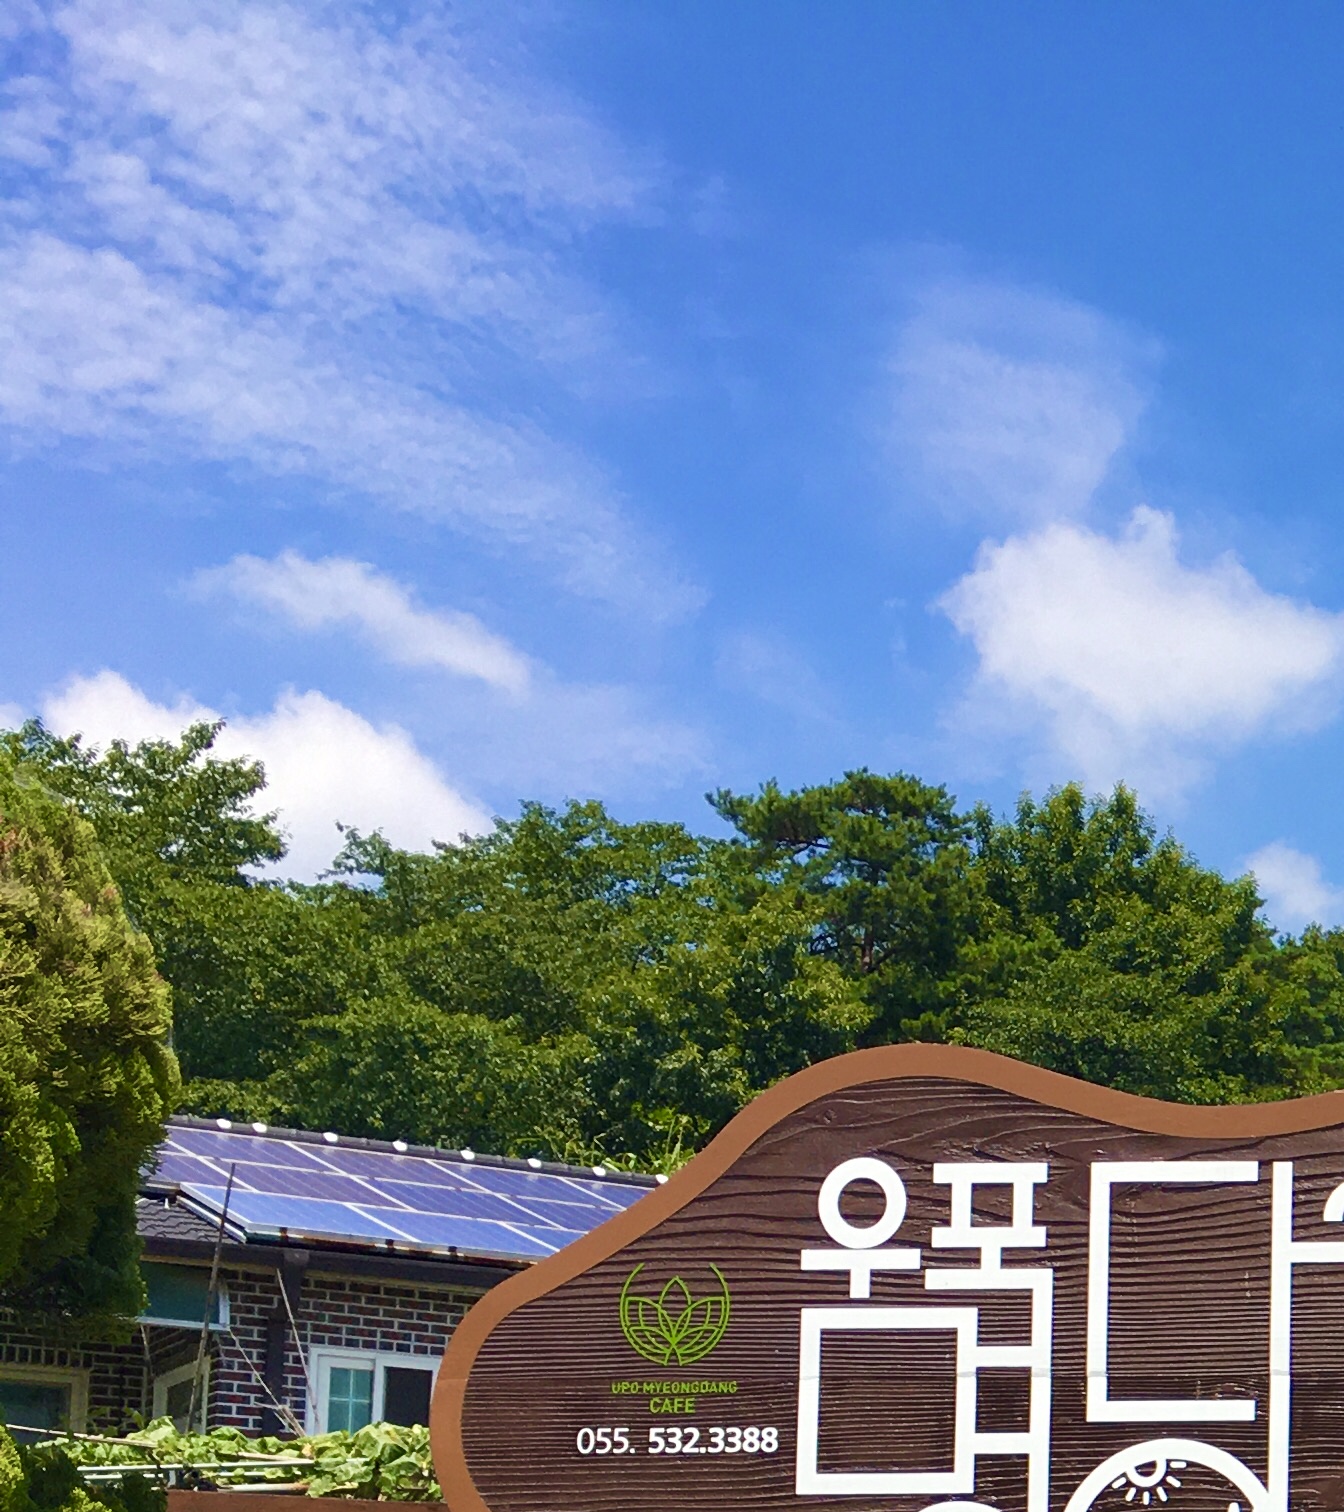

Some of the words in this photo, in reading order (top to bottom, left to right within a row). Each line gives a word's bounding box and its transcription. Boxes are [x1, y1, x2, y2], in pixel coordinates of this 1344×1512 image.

[611, 1381, 639, 1394] UPO
[642, 1380, 738, 1394] MYEONGDANG
[649, 1396, 696, 1414] CAFE
[576, 1427, 636, 1454] 055.
[648, 1426, 779, 1454] 532.3388
